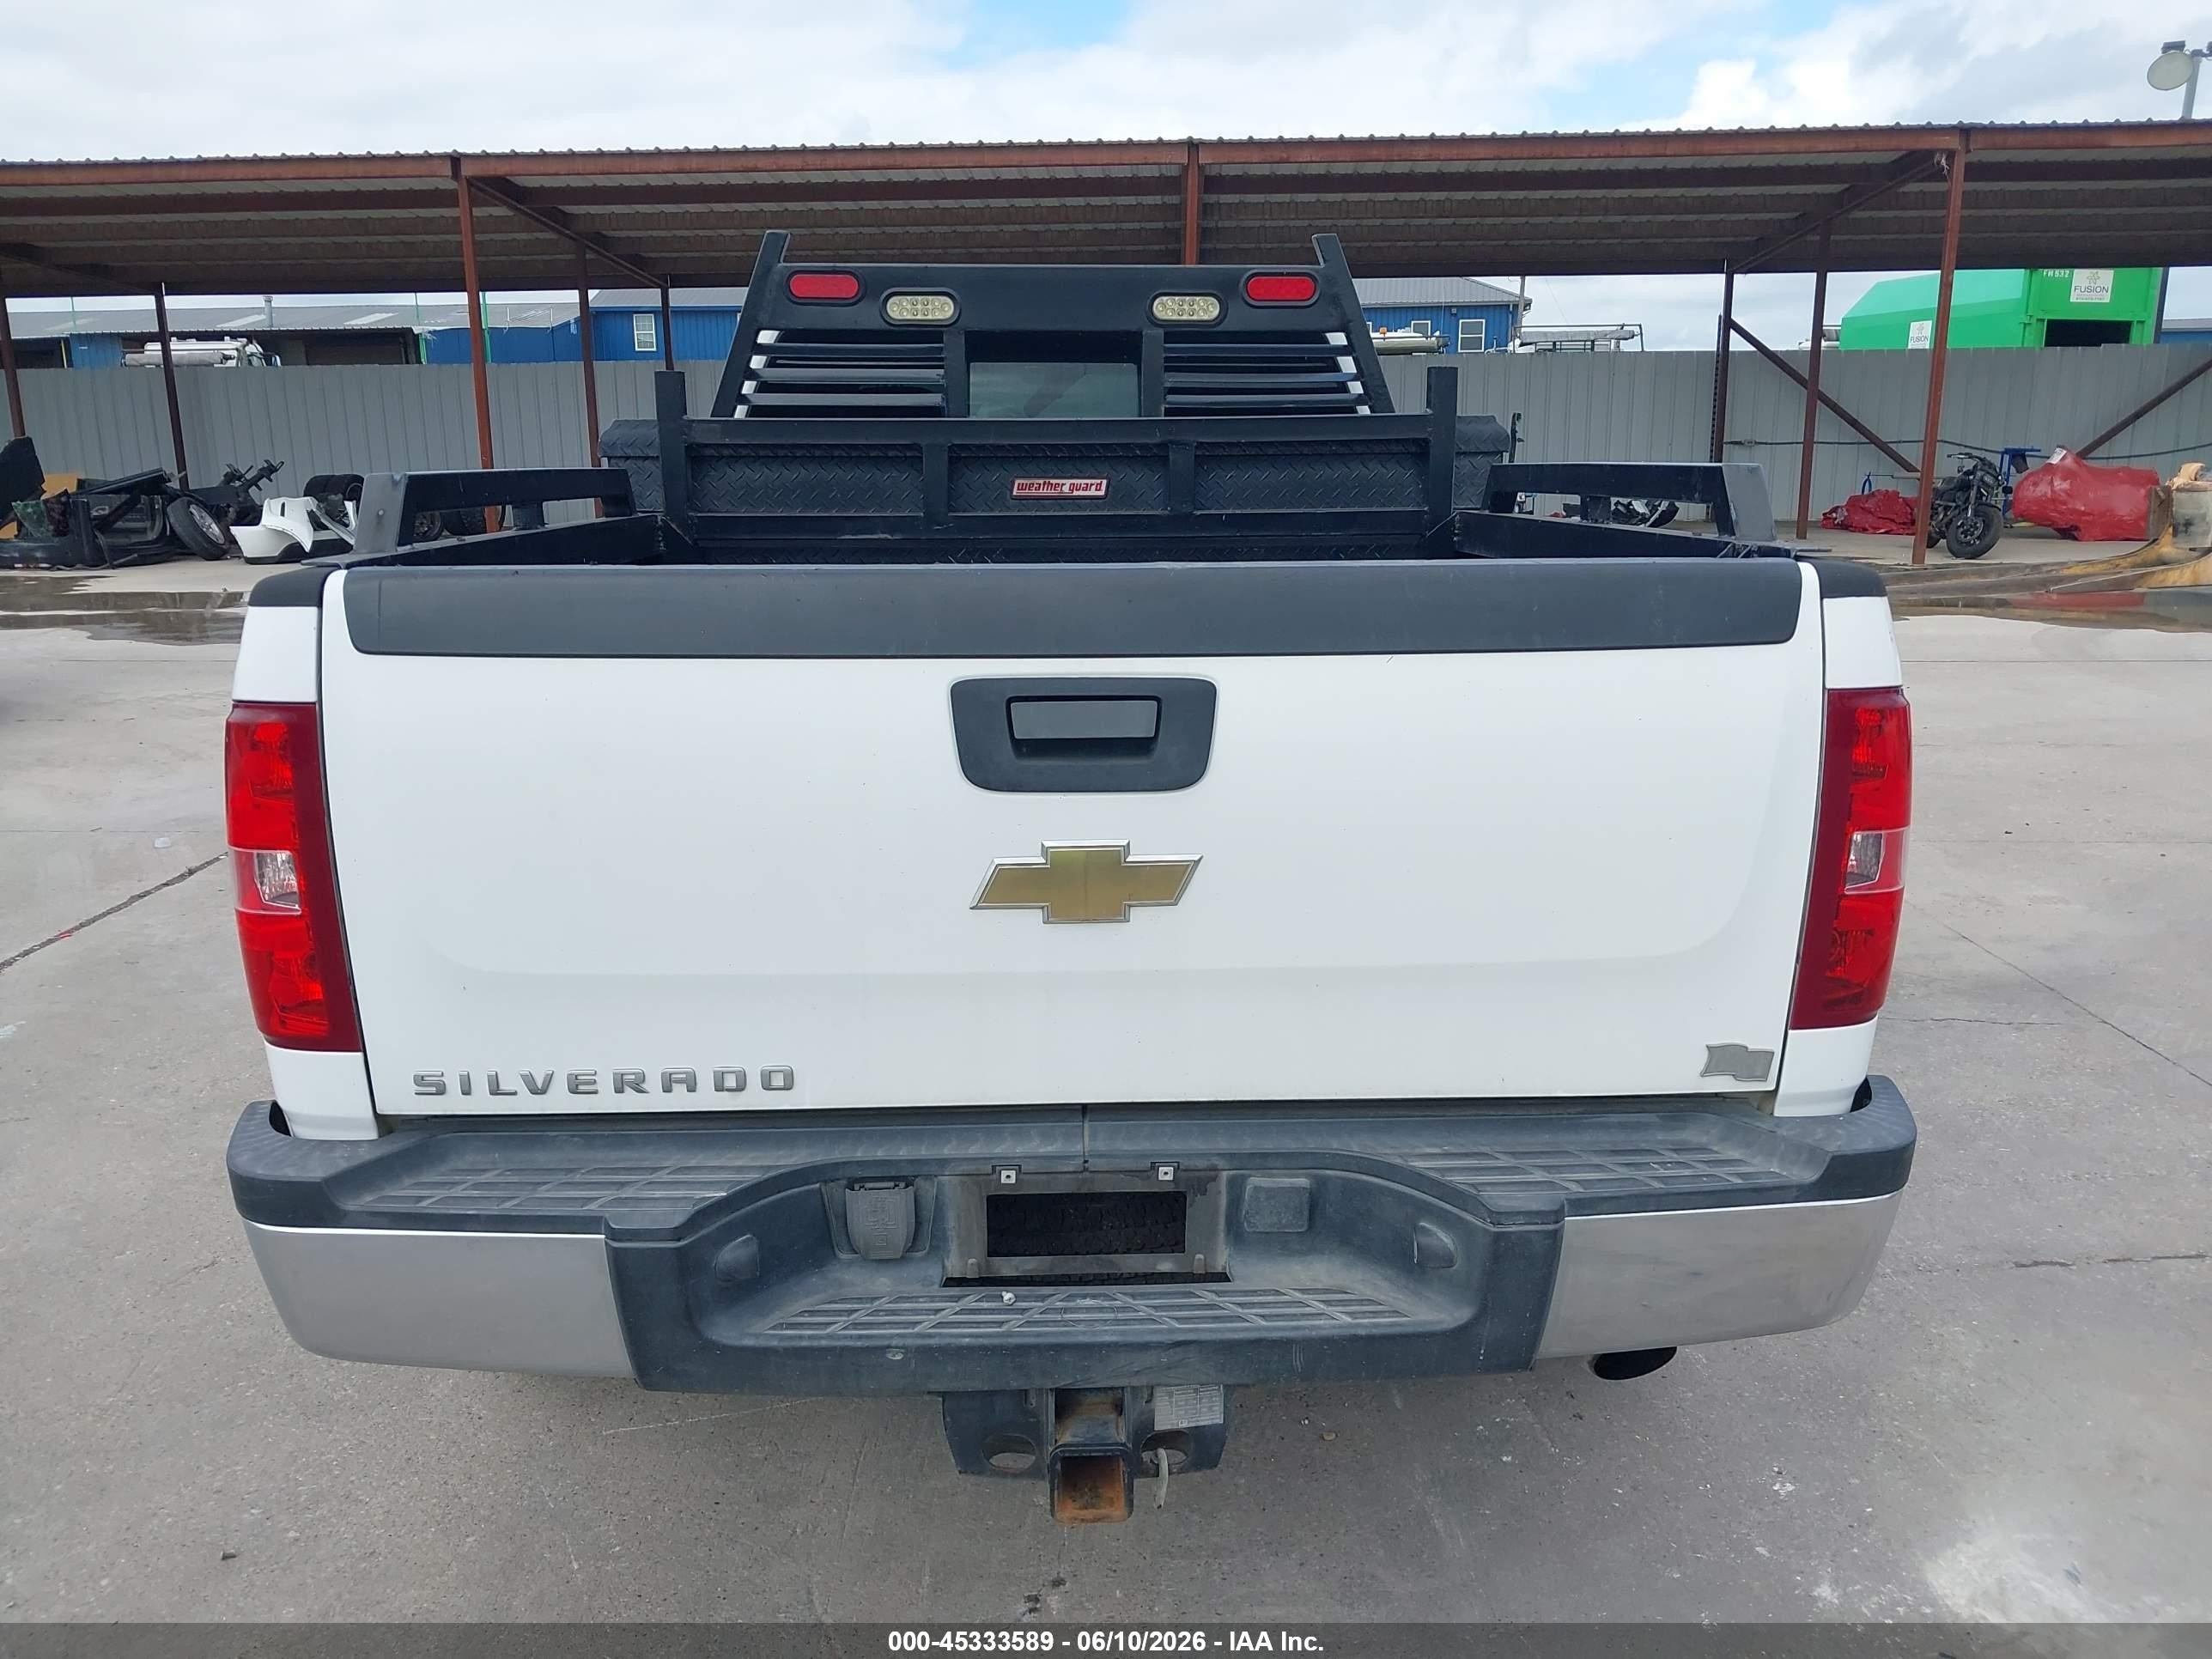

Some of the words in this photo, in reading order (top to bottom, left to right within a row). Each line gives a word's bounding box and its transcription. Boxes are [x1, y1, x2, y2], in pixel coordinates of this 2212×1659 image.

[2074, 285, 2109, 294] FUSION
[1017, 480, 1066, 492] weather
[1068, 480, 1103, 494] guard
[413, 1065, 795, 1096] SILVERADO
